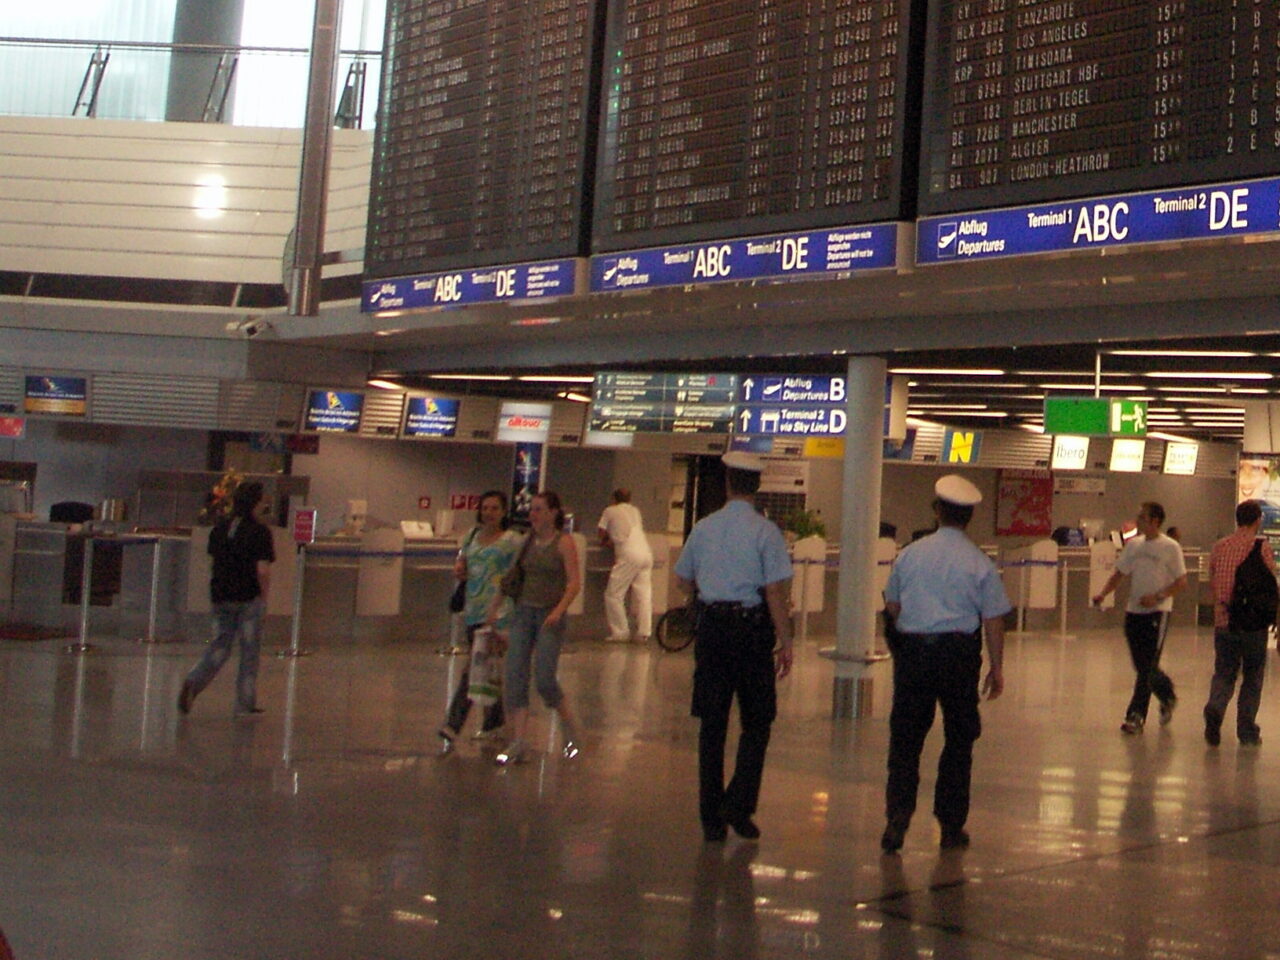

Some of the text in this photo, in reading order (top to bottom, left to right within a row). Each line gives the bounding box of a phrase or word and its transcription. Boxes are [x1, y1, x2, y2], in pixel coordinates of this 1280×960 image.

[1027, 202, 1129, 244] Terminal 1 ABC
[1153, 188, 1249, 230] Terminal 2 DE
[958, 220, 988, 237] Abflug
[747, 242, 775, 256] Terminal
[781, 237, 809, 270] DE
[957, 238, 1005, 256] Departures
[693, 245, 732, 279] ABC
[433, 274, 463, 303] ABC
[496, 269, 517, 298] DE
[782, 377, 846, 402] Departures B
[781, 408, 825, 422] Terminal 2
[829, 409, 848, 435] D
